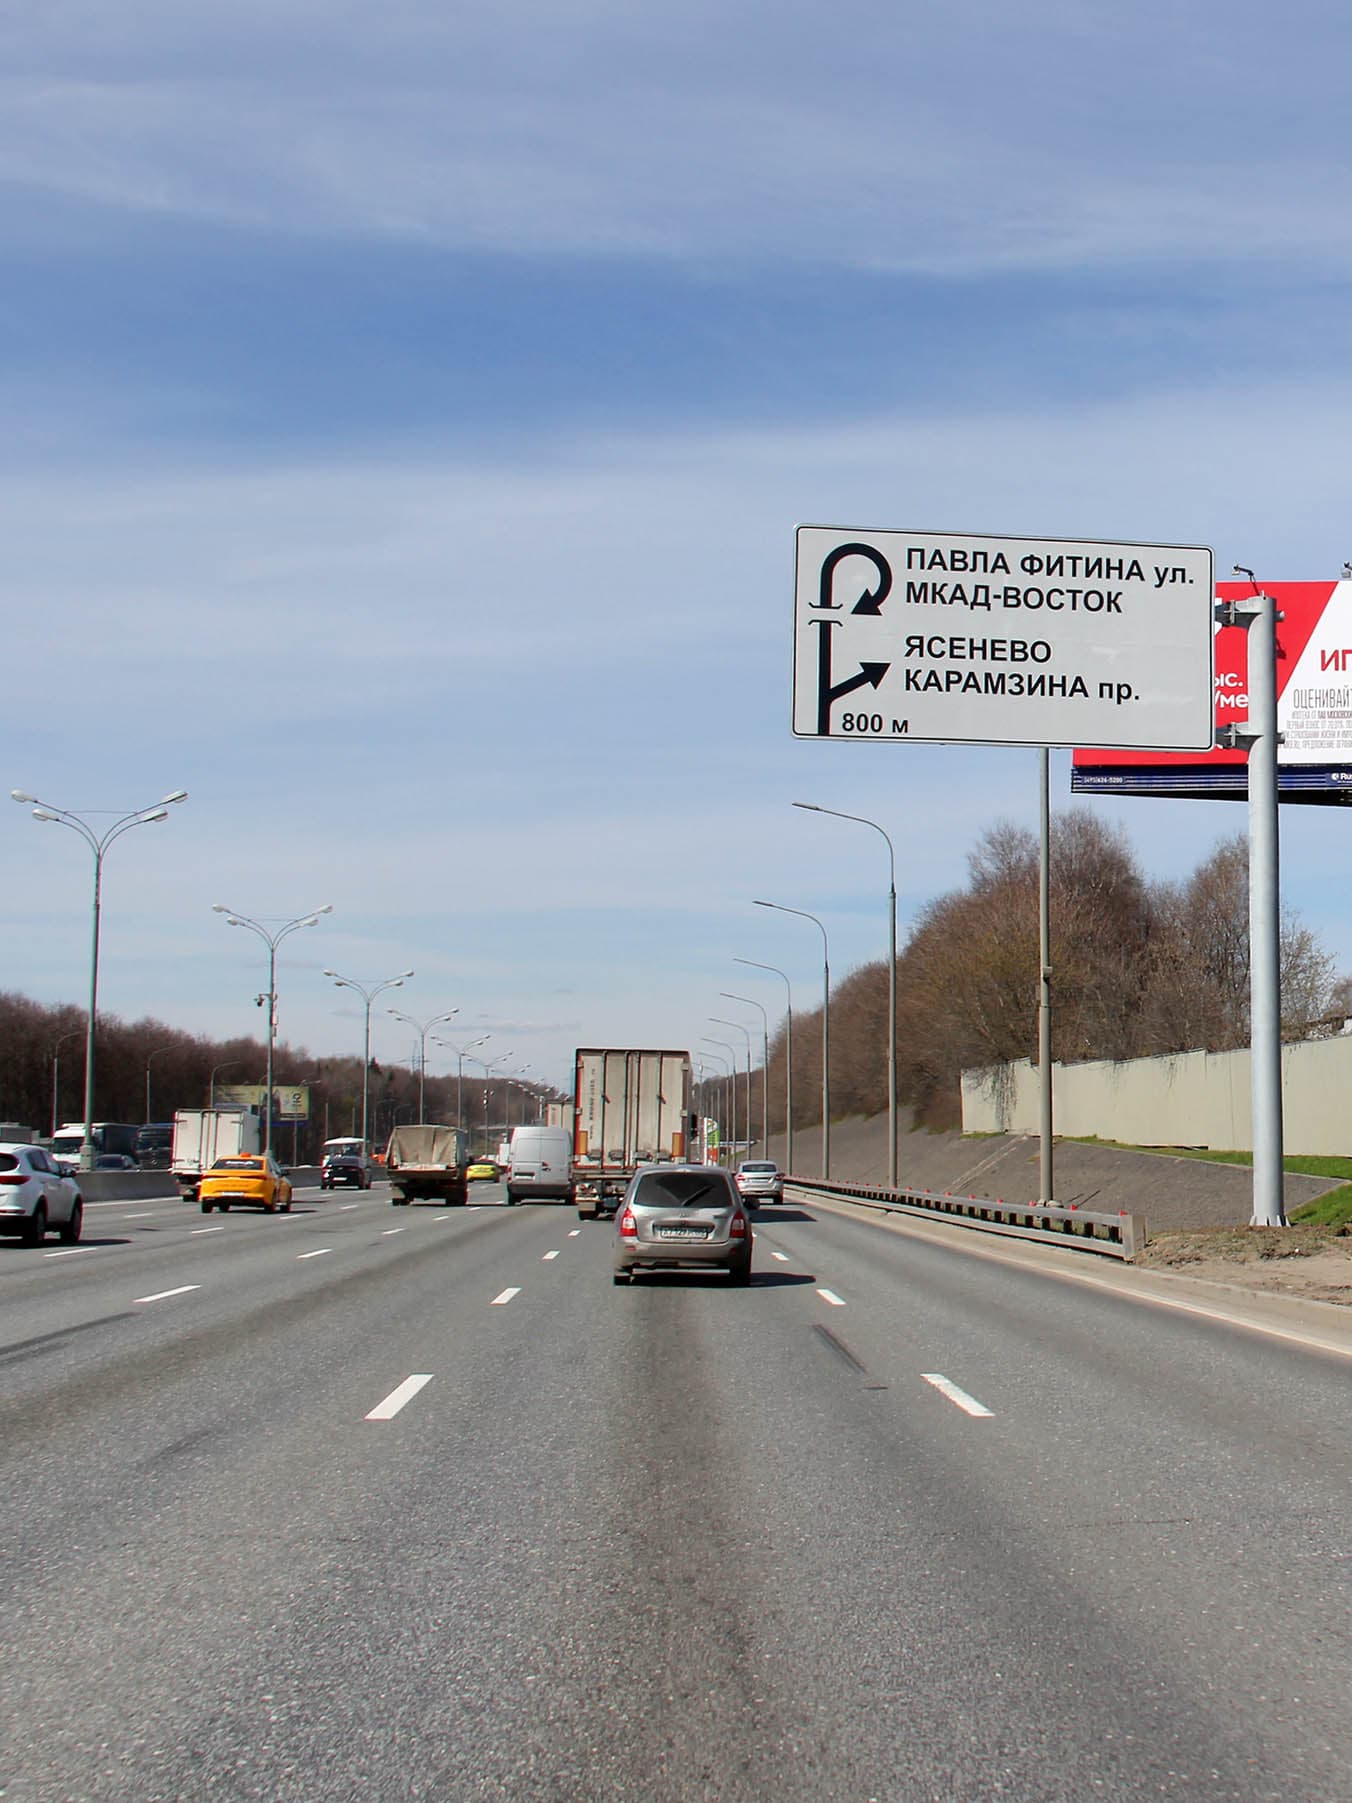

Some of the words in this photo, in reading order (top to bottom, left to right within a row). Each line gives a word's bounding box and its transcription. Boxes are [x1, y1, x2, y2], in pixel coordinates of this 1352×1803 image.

[906, 548, 1010, 574] ПАВЛА
[1020, 554, 1145, 581] ФИТИНА
[1153, 566, 1194, 588] ул.
[906, 581, 1123, 613] МКАД-ВОСТОК
[904, 636, 1051, 663] ЯСЕНЕВО
[905, 669, 1089, 697] КАРАМЗИНА
[1098, 682, 1140, 705] пр.
[842, 713, 884, 733] 800
[892, 720, 909, 733] м
